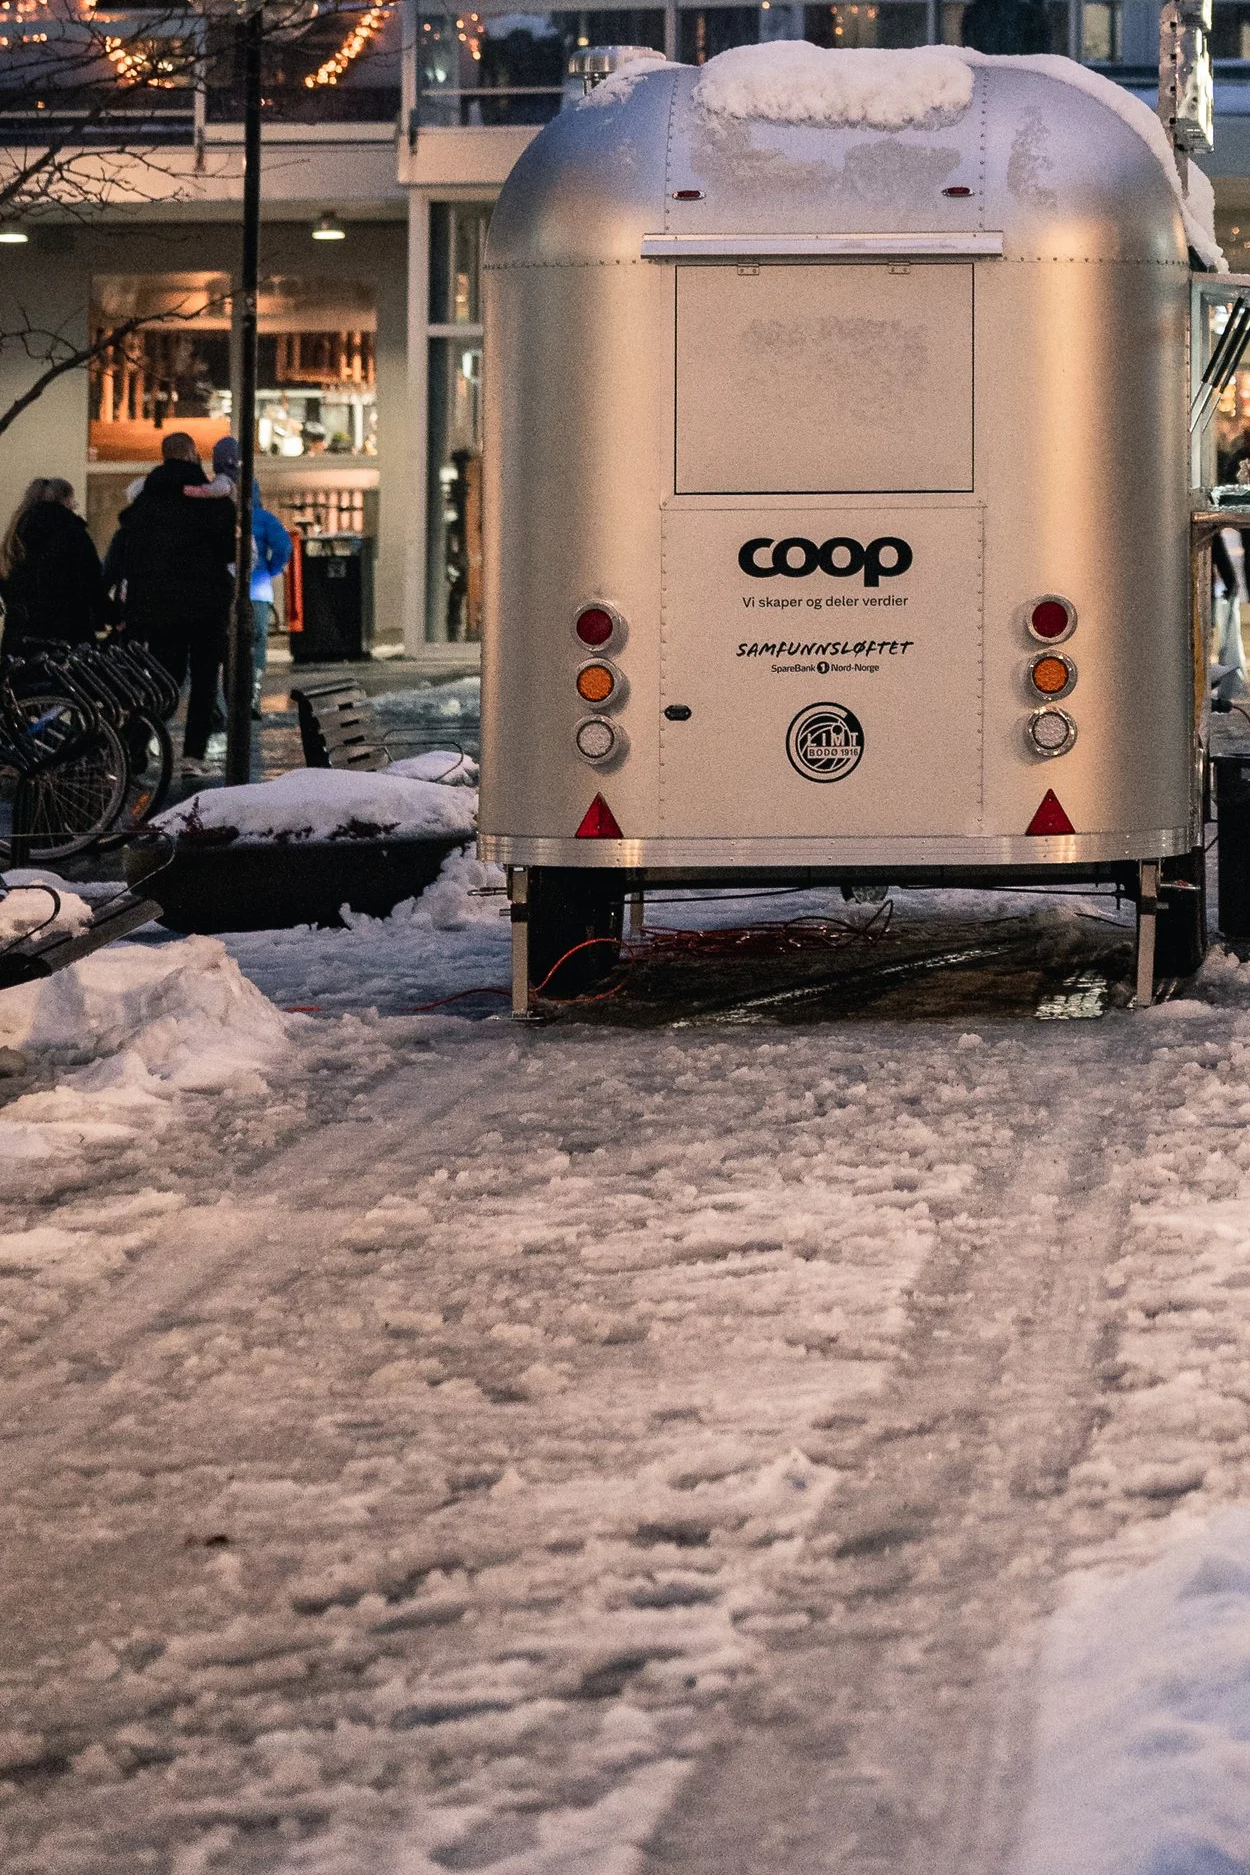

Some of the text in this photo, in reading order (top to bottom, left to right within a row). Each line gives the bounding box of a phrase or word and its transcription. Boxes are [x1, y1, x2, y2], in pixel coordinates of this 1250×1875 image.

[738, 536, 913, 588] coop
[742, 595, 908, 610] Vi skaper og deler verdier
[736, 640, 914, 658] SAMFUNNSLØFTET
[771, 664, 815, 674] SpareBank
[831, 663, 879, 673] Nord-Norge
[808, 748, 859, 757] BODØ 1916
